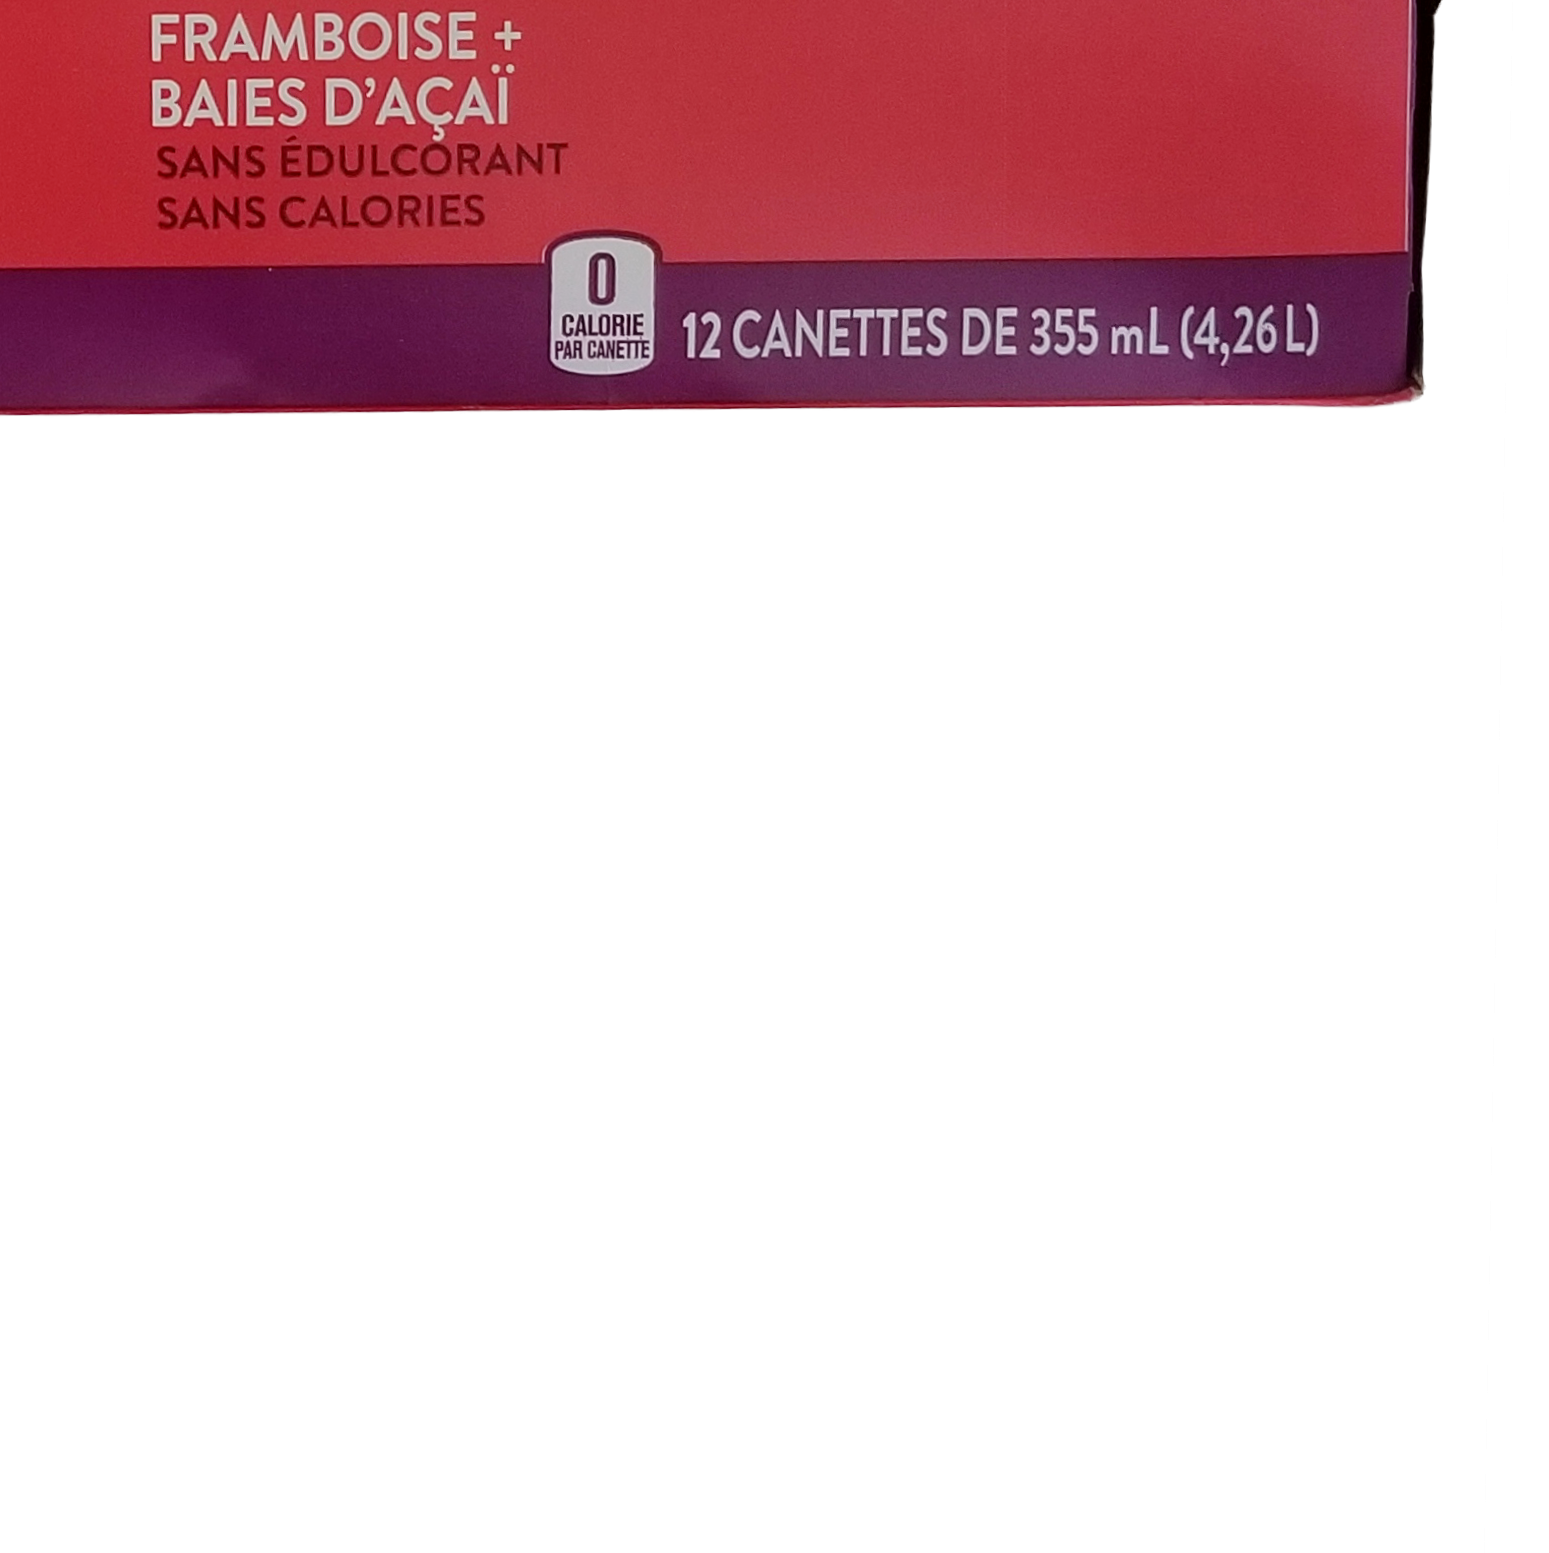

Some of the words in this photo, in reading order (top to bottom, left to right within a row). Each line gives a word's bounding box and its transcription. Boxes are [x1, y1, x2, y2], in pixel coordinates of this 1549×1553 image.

[151, 12, 476, 61] FRAMBOISE
[494, 20, 521, 50] +
[151, 78, 306, 127] BAIES
[157, 144, 266, 178] SANS
[281, 135, 569, 177] ÉDULCORANT
[157, 195, 266, 230] SANS
[278, 194, 485, 228] CALORIES
[587, 252, 616, 306] 0
[561, 313, 644, 336] CALORIE
[683, 312, 722, 359] 12
[732, 307, 948, 358] CANETTES
[962, 309, 1018, 355] DE
[1029, 307, 1099, 355] 355
[1110, 305, 1169, 355] mL
[554, 340, 584, 359] PAR
[587, 339, 650, 359] CANETTE
